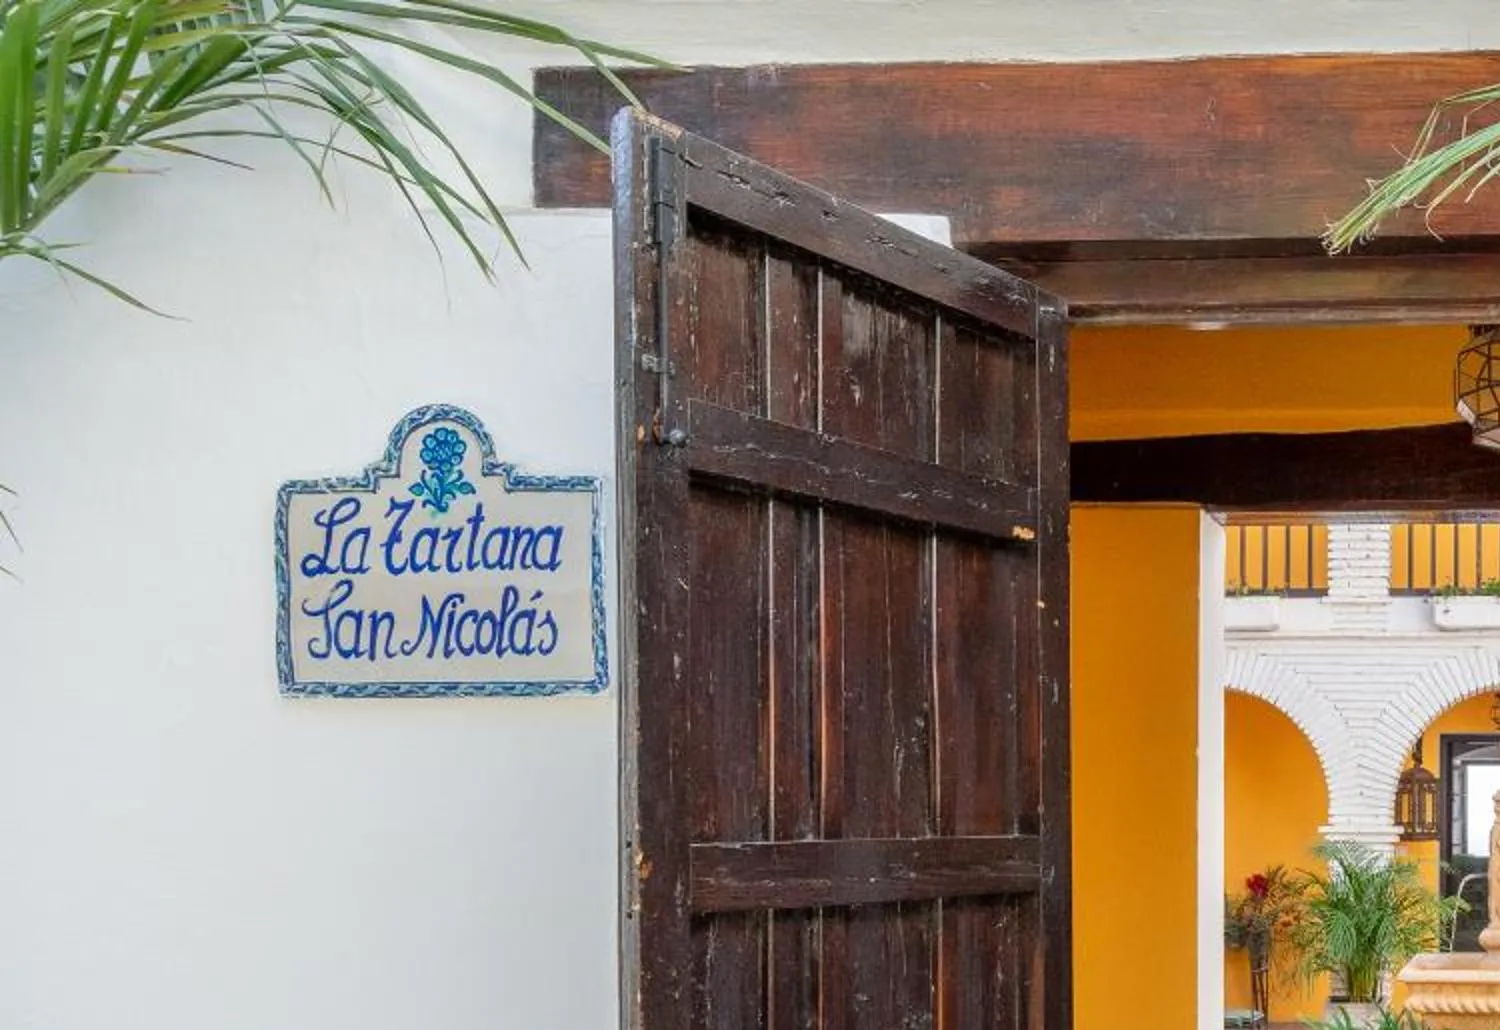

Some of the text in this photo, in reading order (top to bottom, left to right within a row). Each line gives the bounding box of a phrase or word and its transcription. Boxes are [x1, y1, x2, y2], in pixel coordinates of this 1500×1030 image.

[301, 496, 565, 578] La Tartana
[301, 579, 559, 662] San Nicolás
